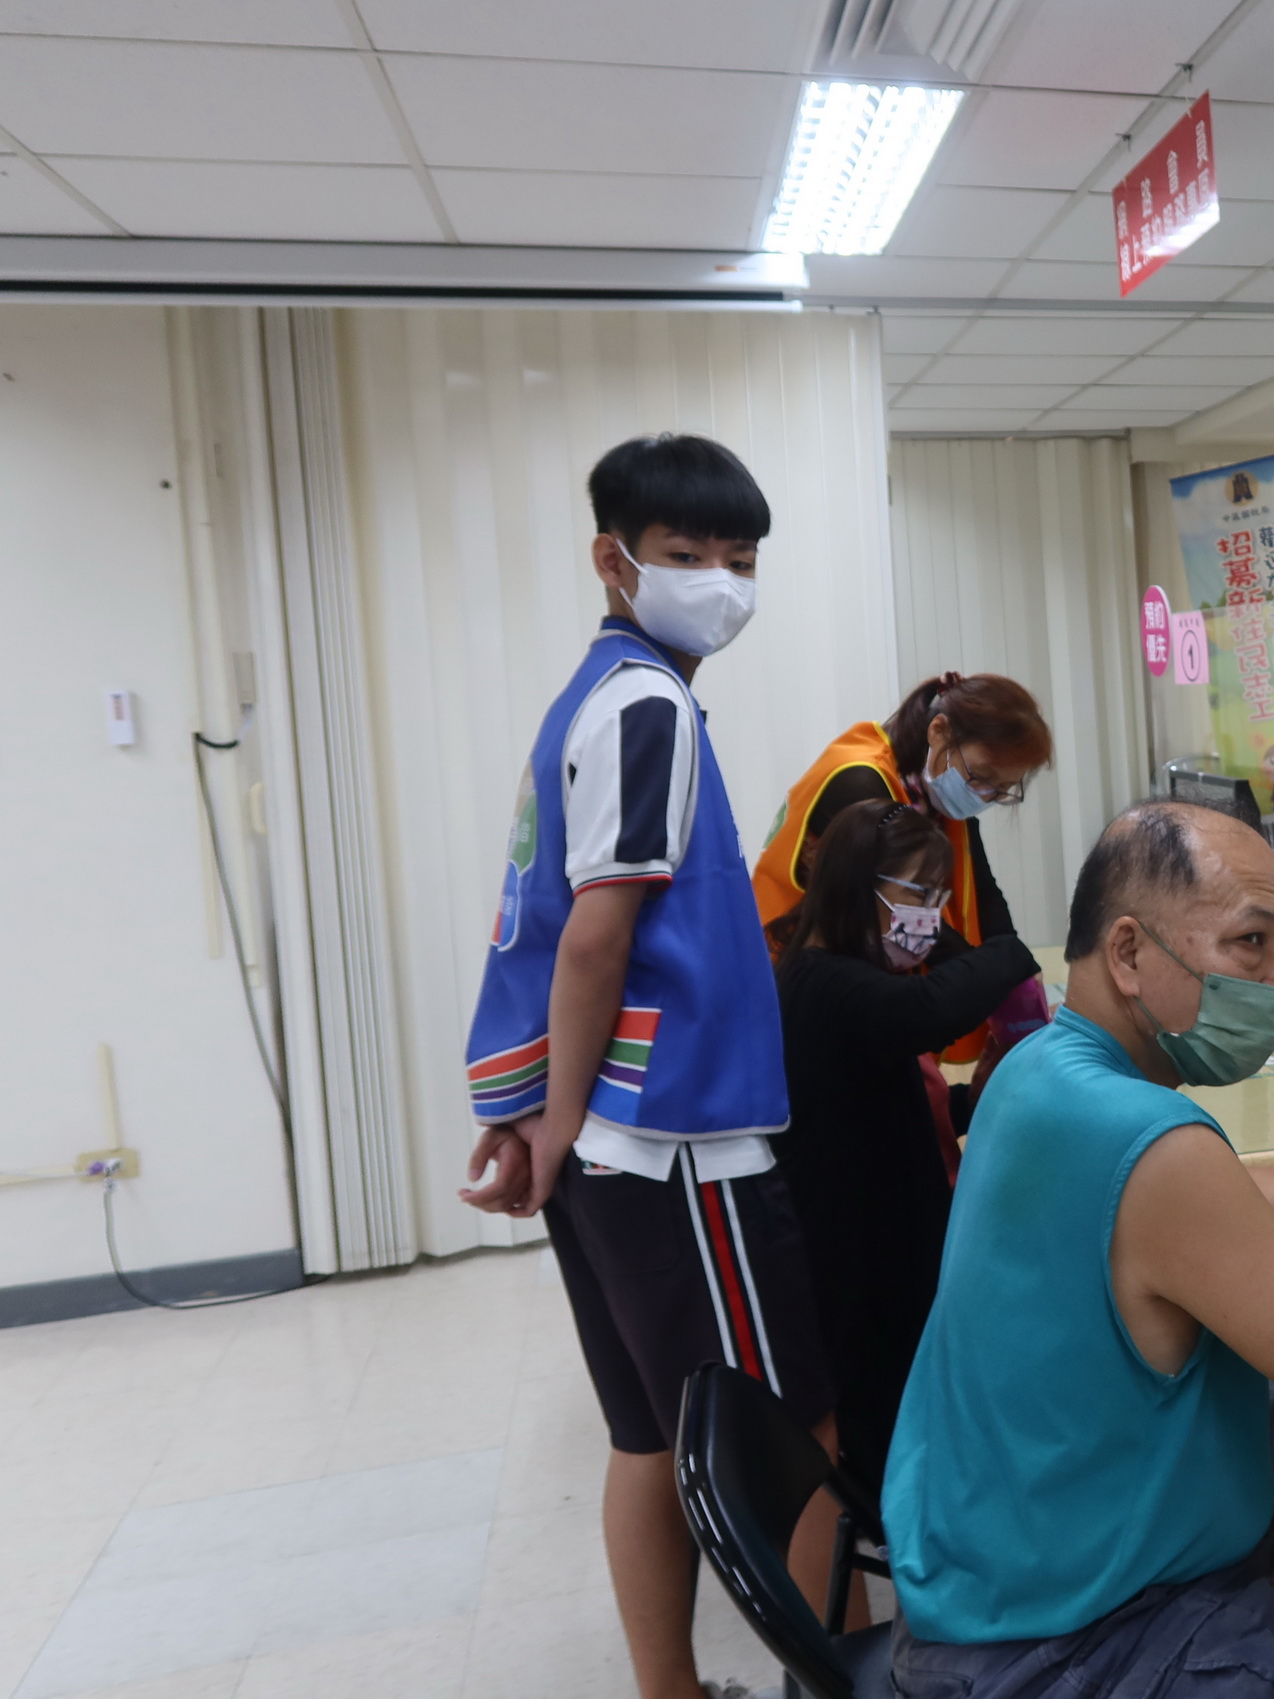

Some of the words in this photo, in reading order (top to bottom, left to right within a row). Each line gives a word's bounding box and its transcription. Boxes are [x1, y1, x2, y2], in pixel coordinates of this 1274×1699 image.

[1144, 601, 1165, 629] 預約
[1146, 634, 1167, 662] 優先
[1187, 643, 1195, 670] 1
